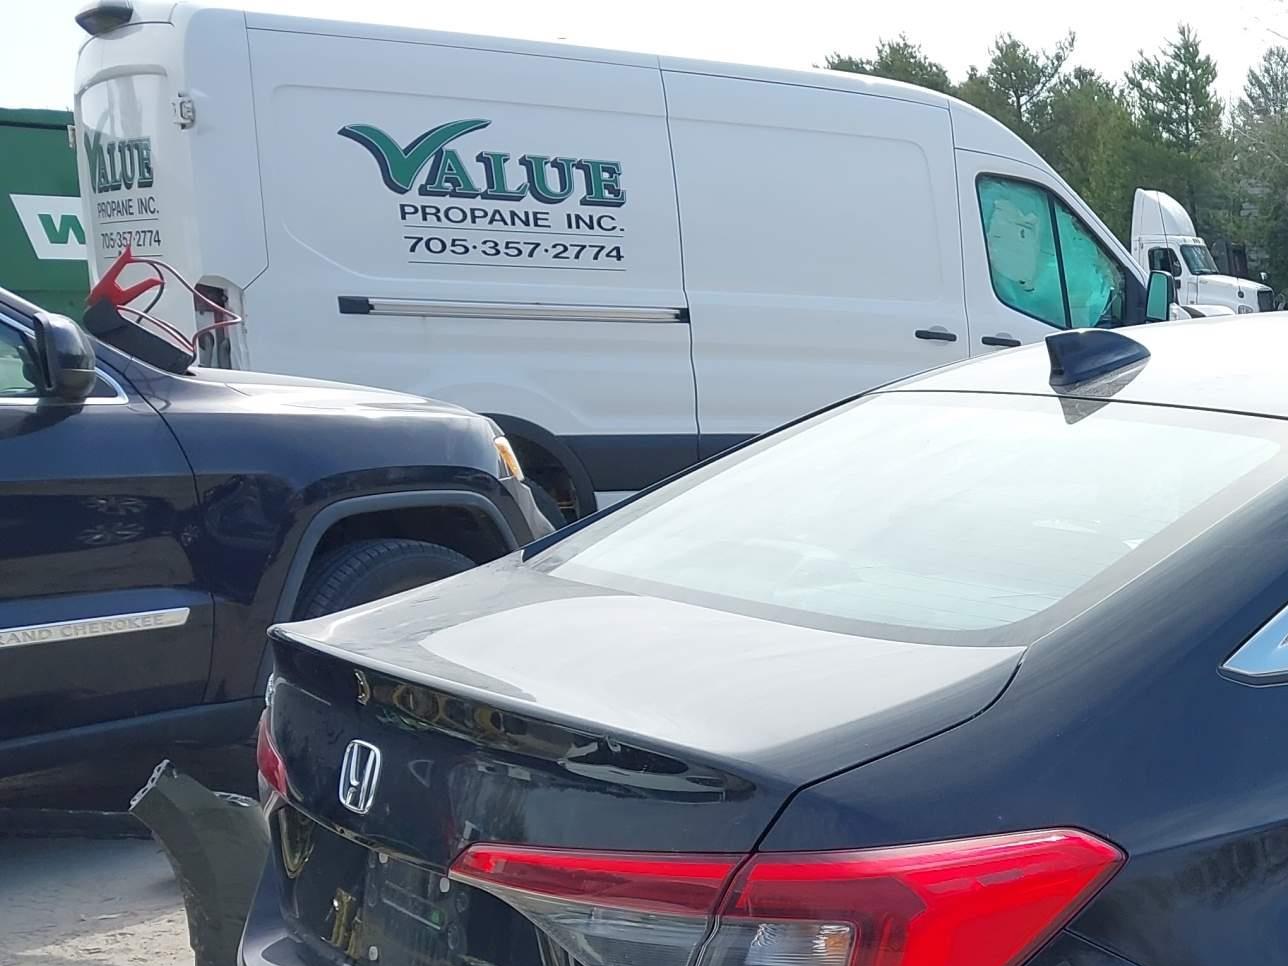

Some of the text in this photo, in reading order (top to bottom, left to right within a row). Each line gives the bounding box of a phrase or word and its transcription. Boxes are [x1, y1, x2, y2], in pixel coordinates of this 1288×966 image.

[83, 129, 154, 194] VALUE
[337, 118, 627, 208] VALUE
[97, 196, 160, 219] PROPANE INC.
[399, 203, 625, 232] PROPANE INC.
[61, 614, 165, 638] CHEROKEE
